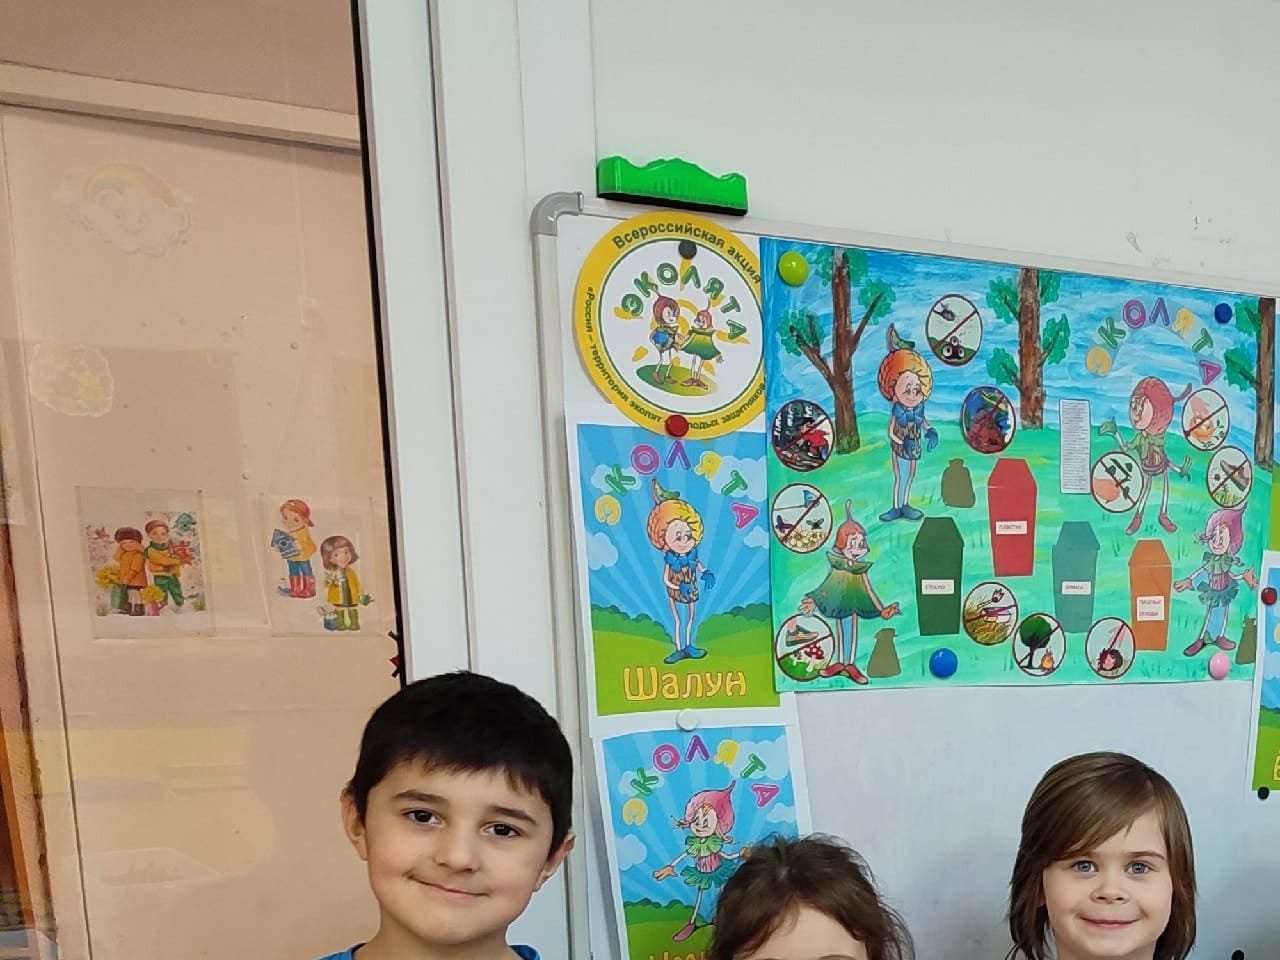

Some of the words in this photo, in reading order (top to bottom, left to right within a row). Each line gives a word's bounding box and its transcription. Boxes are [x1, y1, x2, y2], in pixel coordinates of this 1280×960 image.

[613, 222, 725, 250] Всероссийская
[726, 244, 762, 284] акция
[621, 262, 748, 340] ЭКОЛЯТА
[623, 664, 748, 702] Шалун
